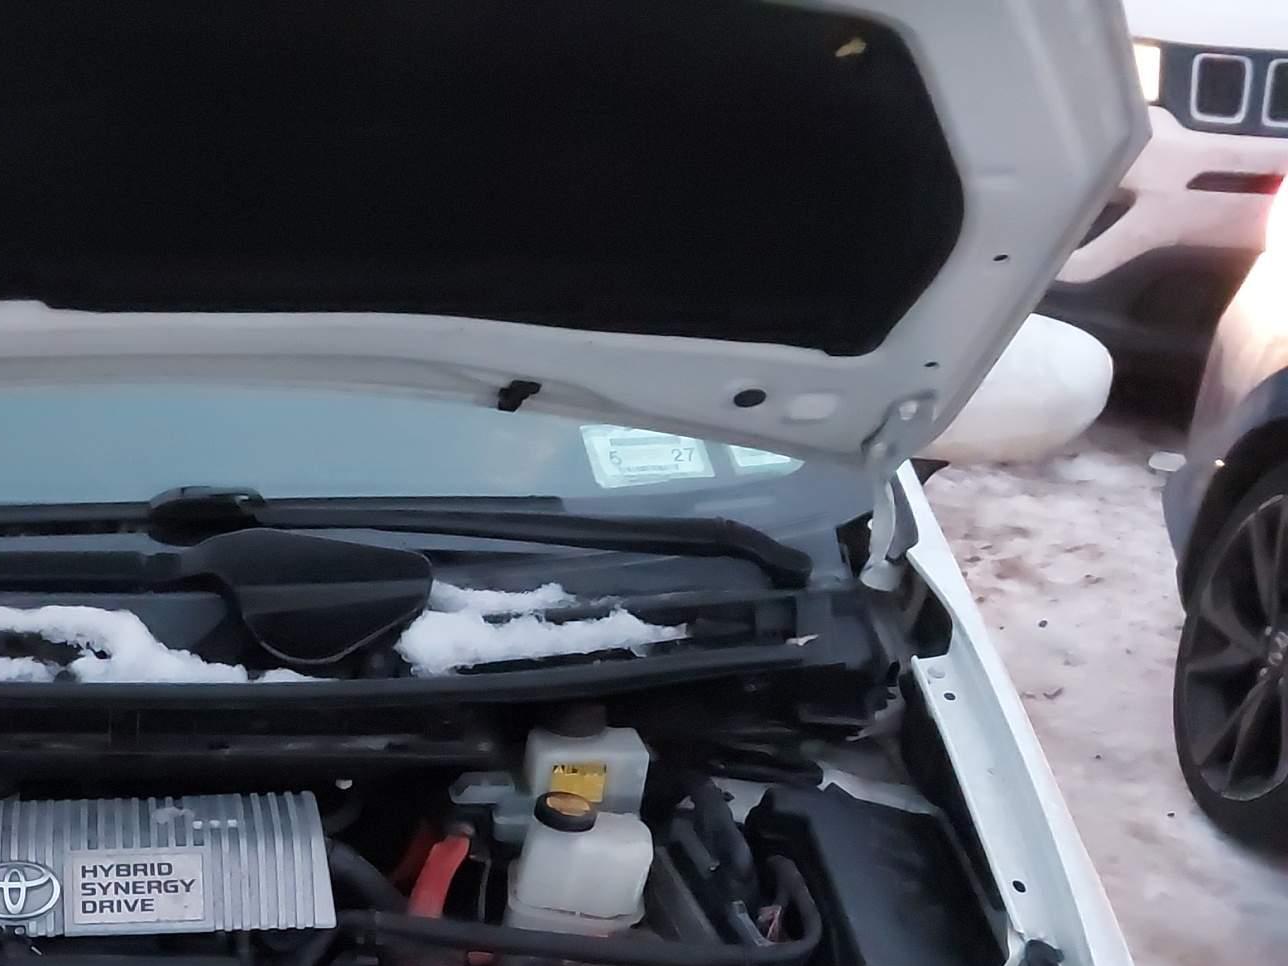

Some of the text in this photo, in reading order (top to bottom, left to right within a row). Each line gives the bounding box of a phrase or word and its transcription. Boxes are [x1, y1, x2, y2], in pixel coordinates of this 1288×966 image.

[609, 447, 695, 465] 5 27
[81, 862, 173, 878] HYBRID
[81, 879, 196, 896] SYNERGY
[81, 898, 155, 914] DRIVE
